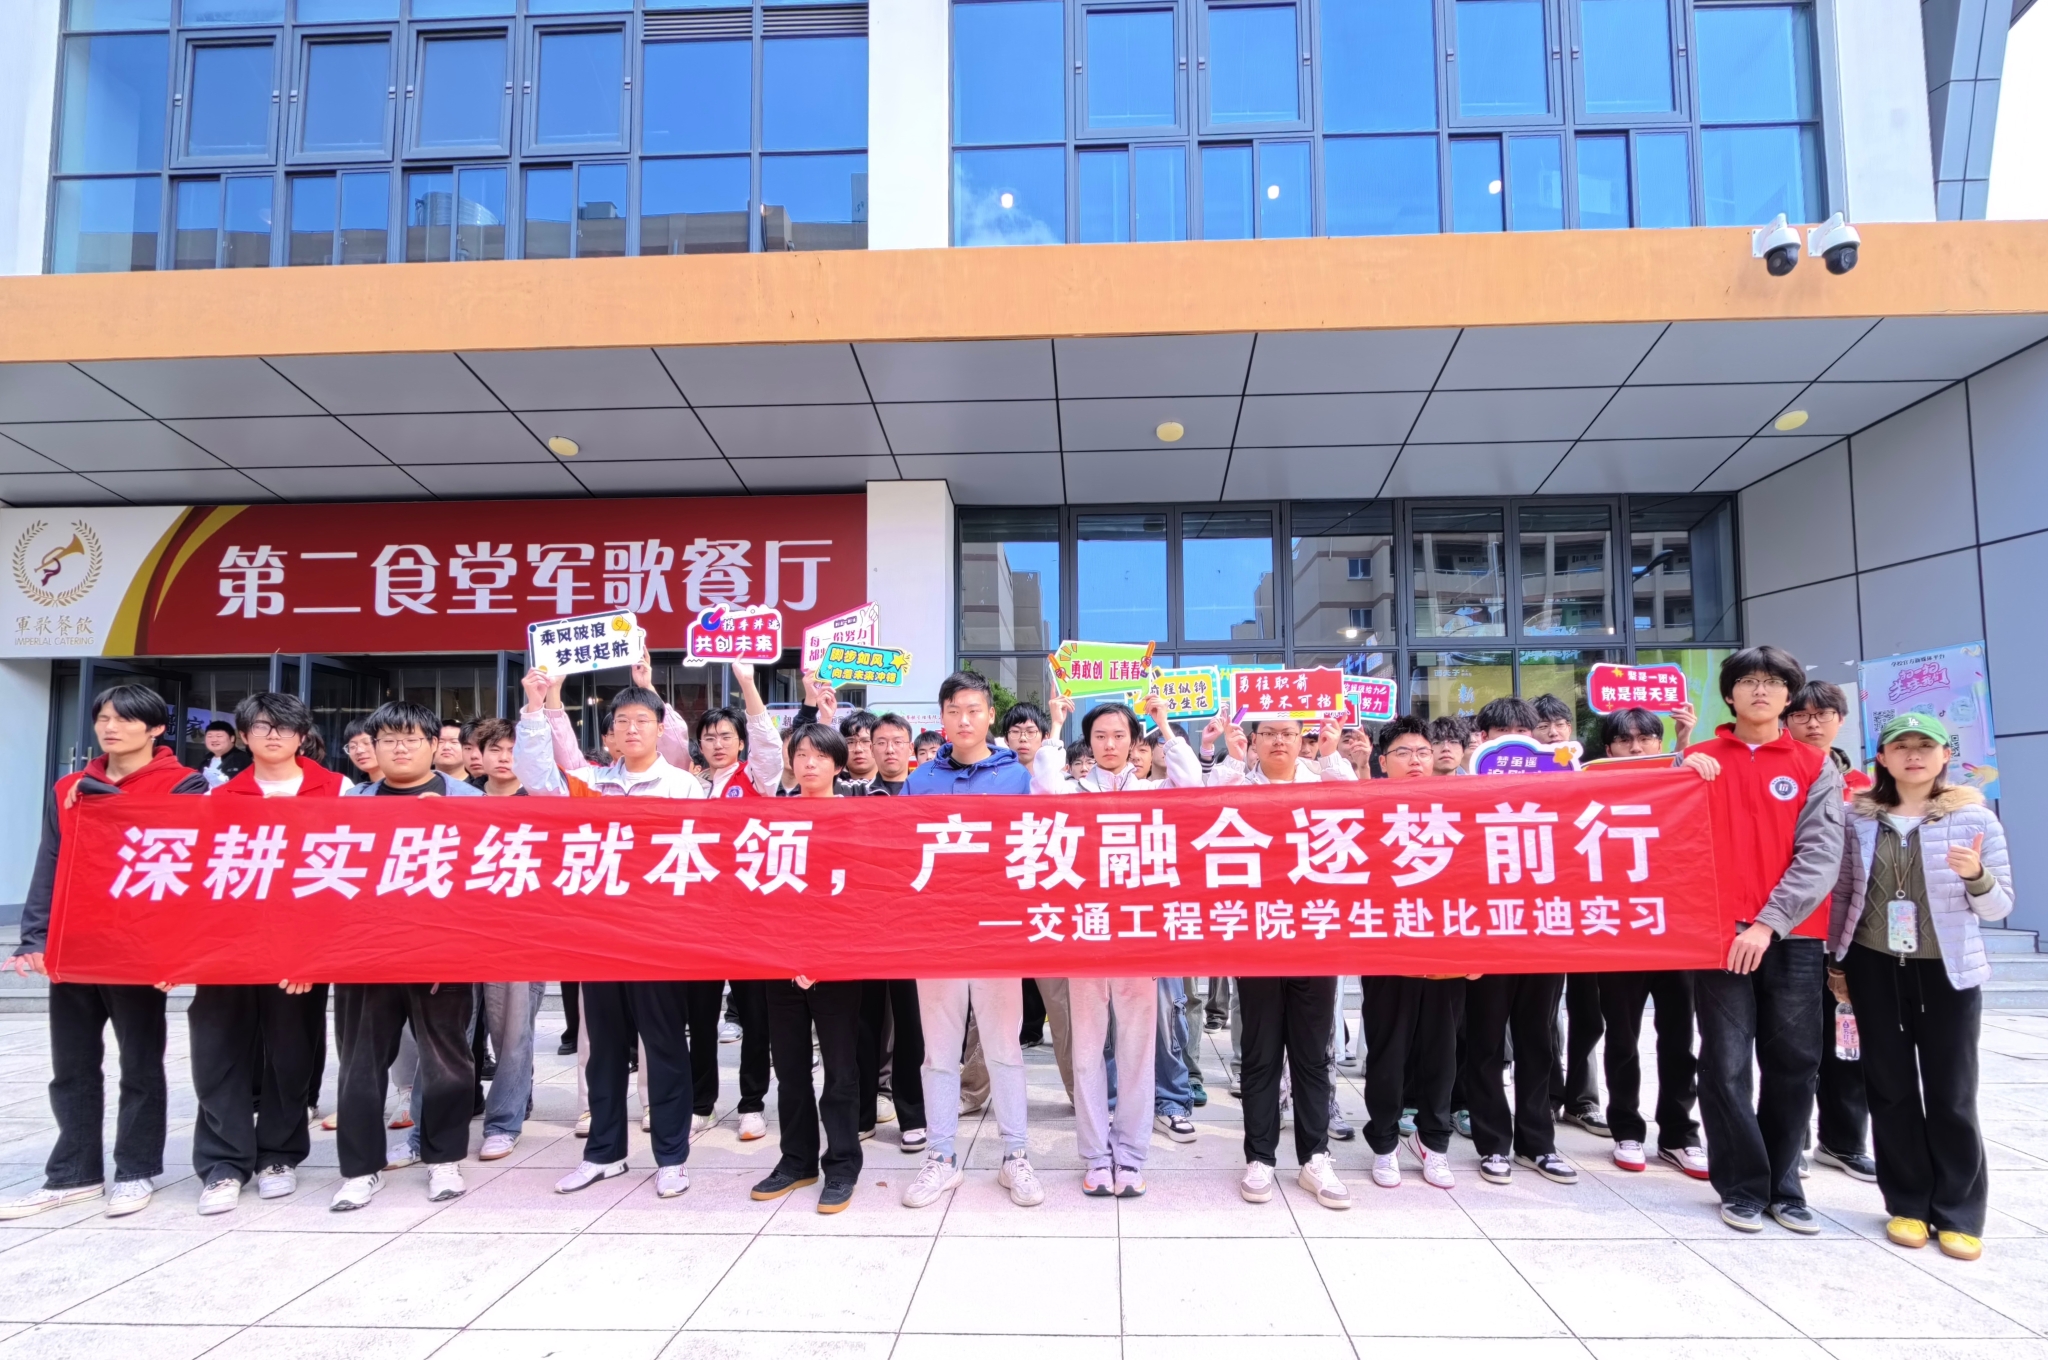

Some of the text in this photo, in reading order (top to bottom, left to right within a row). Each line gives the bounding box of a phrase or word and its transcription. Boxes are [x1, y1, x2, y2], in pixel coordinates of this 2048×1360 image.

[217, 538, 832, 619] 第二食堂军歌餐厅
[15, 615, 94, 636] 軍歌餐飲
[540, 622, 606, 646] 乘风破浪
[721, 617, 780, 632] 携手并进
[54, 636, 94, 645] CATERING
[695, 634, 774, 653] 共创未来
[810, 628, 867, 648] 每一份努力
[556, 640, 630, 667] 梦想起航
[830, 647, 884, 668] 脚步如风
[832, 667, 897, 684] 向着未来冲锋
[1071, 660, 1140, 681] 勇敢创 正青春
[1627, 670, 1678, 685] 聚是一团火
[1239, 673, 1309, 693] 勇往职前
[1259, 693, 1332, 711] 势不可挡
[1362, 696, 1383, 711] 努力
[1601, 686, 1679, 702] 散是漫天星
[1908, 717, 1919, 727] LA
[1496, 756, 1538, 768] 梦虽遥
[109, 799, 1662, 901] 深耕实践练就本领， 产教融合逐梦前行
